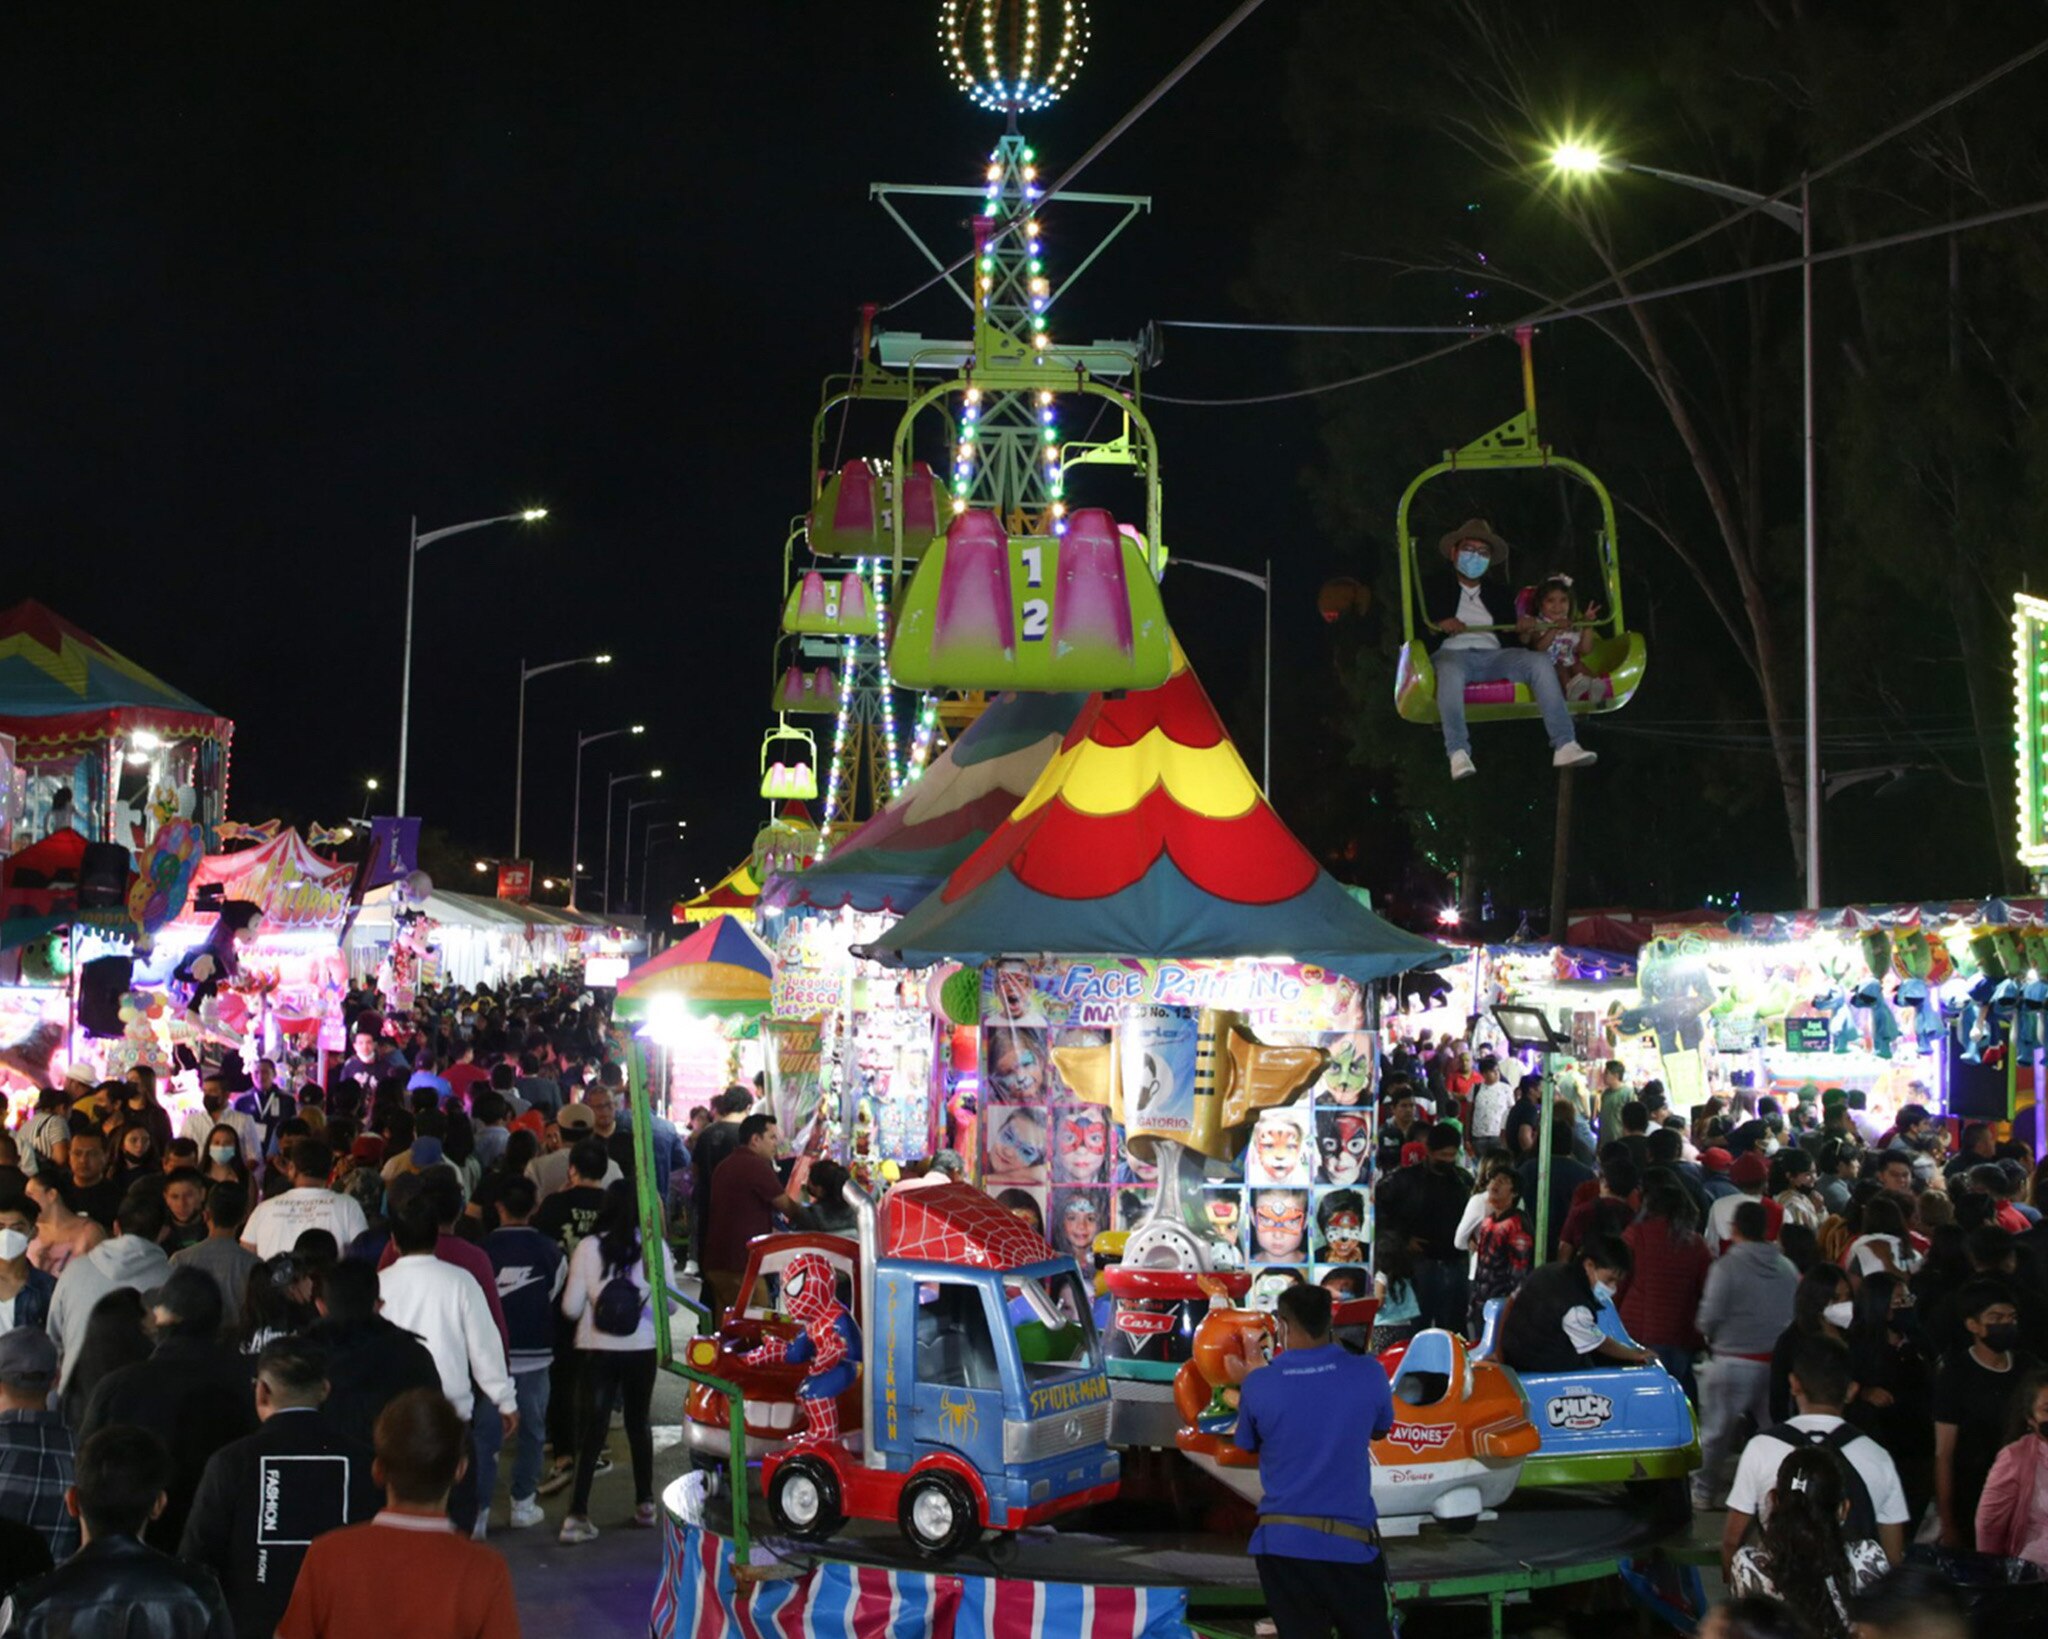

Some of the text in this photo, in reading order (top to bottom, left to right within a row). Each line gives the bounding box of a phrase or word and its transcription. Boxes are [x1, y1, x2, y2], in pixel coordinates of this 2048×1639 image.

[1061, 965, 1144, 998] FACE
[785, 986, 838, 1004] Pesca
[1135, 1115, 1189, 1129] GATORIO
[1119, 1315, 1165, 1329] Cars
[1547, 1395, 1612, 1425] CHUCK
[1393, 1428, 1443, 1441] AVIONES
[263, 1469, 280, 1531] FASHION
